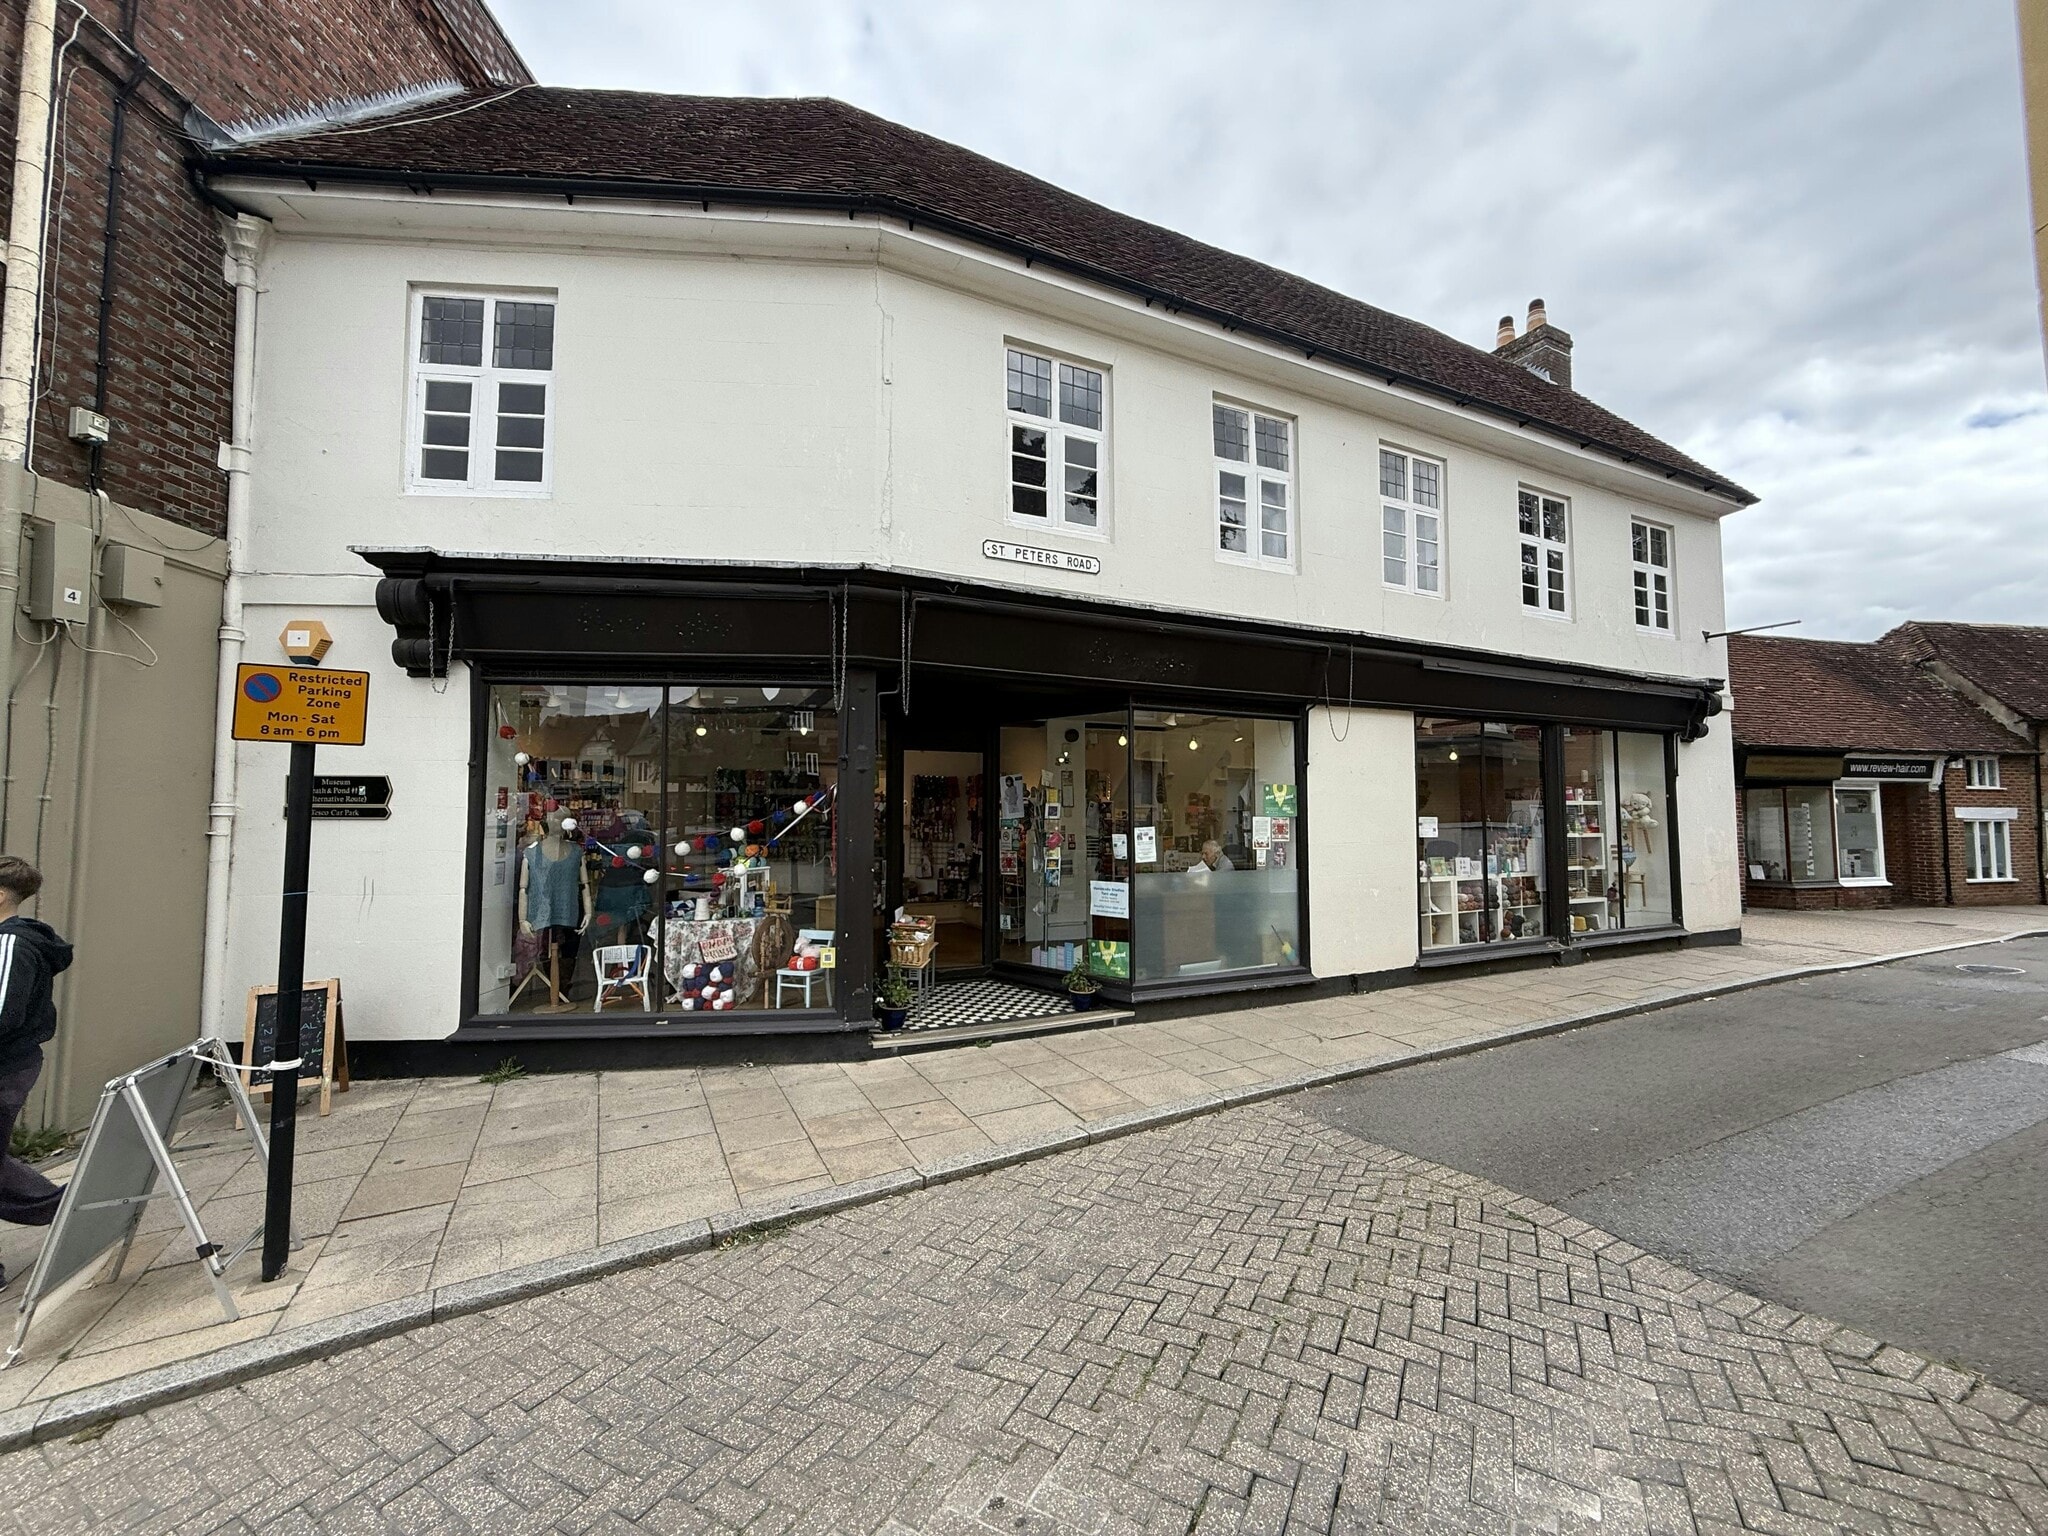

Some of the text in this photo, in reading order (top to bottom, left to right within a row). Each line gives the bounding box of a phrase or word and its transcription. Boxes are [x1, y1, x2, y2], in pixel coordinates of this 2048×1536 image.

[1015, 548, 1058, 564] PETERS
[1067, 556, 1092, 570] ROAD
[67, 591, 77, 601] 4
[289, 672, 362, 686] Restricted
[298, 685, 351, 699] Parking
[306, 698, 340, 708] Zone
[267, 711, 298, 722] Mon
[311, 714, 335, 724] Sat
[260, 725, 270, 735] 8
[273, 727, 294, 736] am
[306, 727, 315, 737] 6
[318, 729, 340, 739] pm
[1850, 763, 1927, 773] www.review-hair.com
